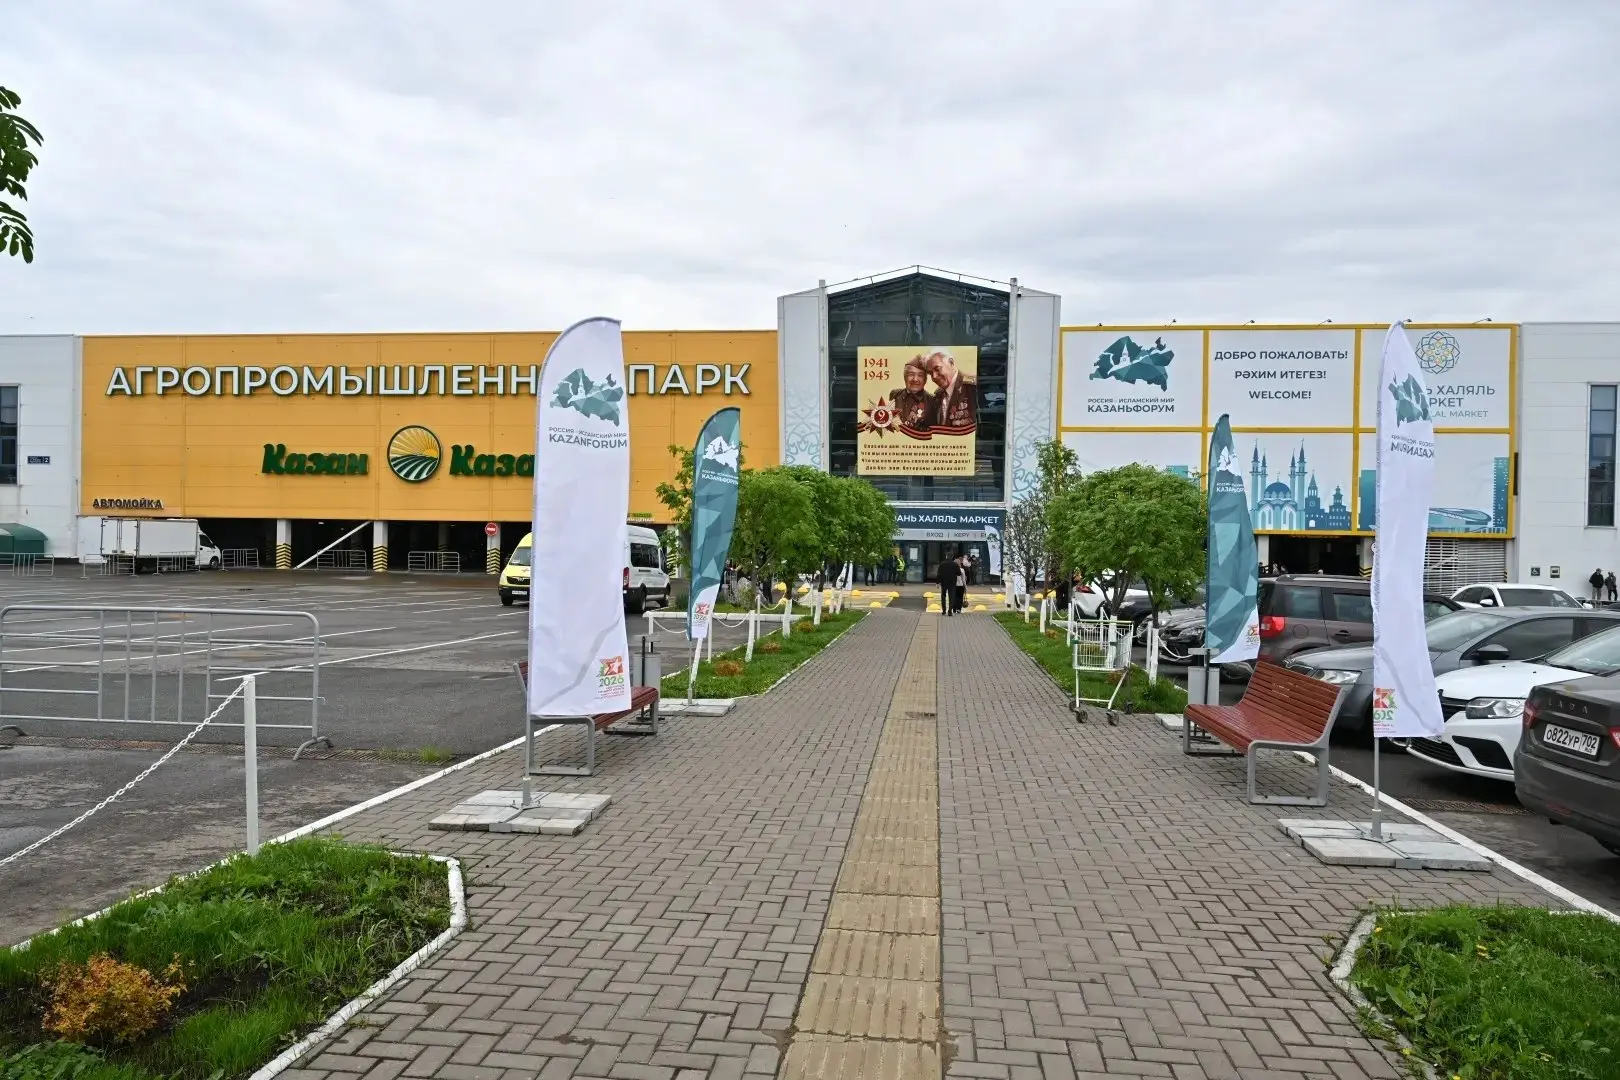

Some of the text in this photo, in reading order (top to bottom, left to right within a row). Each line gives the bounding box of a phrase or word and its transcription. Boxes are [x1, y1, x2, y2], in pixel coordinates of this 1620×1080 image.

[1214, 350, 1348, 360] ДОБРО ПОЖАЛОВАТЬ!
[864, 358, 888, 368] 1941
[864, 371, 890, 380] 1945
[1234, 370, 1326, 379] РӘХИМ ИТЕГЕЗ!
[106, 364, 751, 396] АГРОПРОМЫШЛЕНН ПАРК
[1248, 390, 1312, 399] WELCOME!
[1436, 385, 1496, 395] ХАЛЯЛЬ
[1429, 398, 1464, 407] РКЕТ
[1087, 404, 1175, 413] КАЗАНЬФОРУМ
[549, 433, 628, 449] KAZANFORUM
[261, 443, 369, 476] Казан
[92, 498, 164, 509] АВТОМОЙКА
[599, 676, 624, 687] 2026
[1581, 734, 1598, 750] 702
